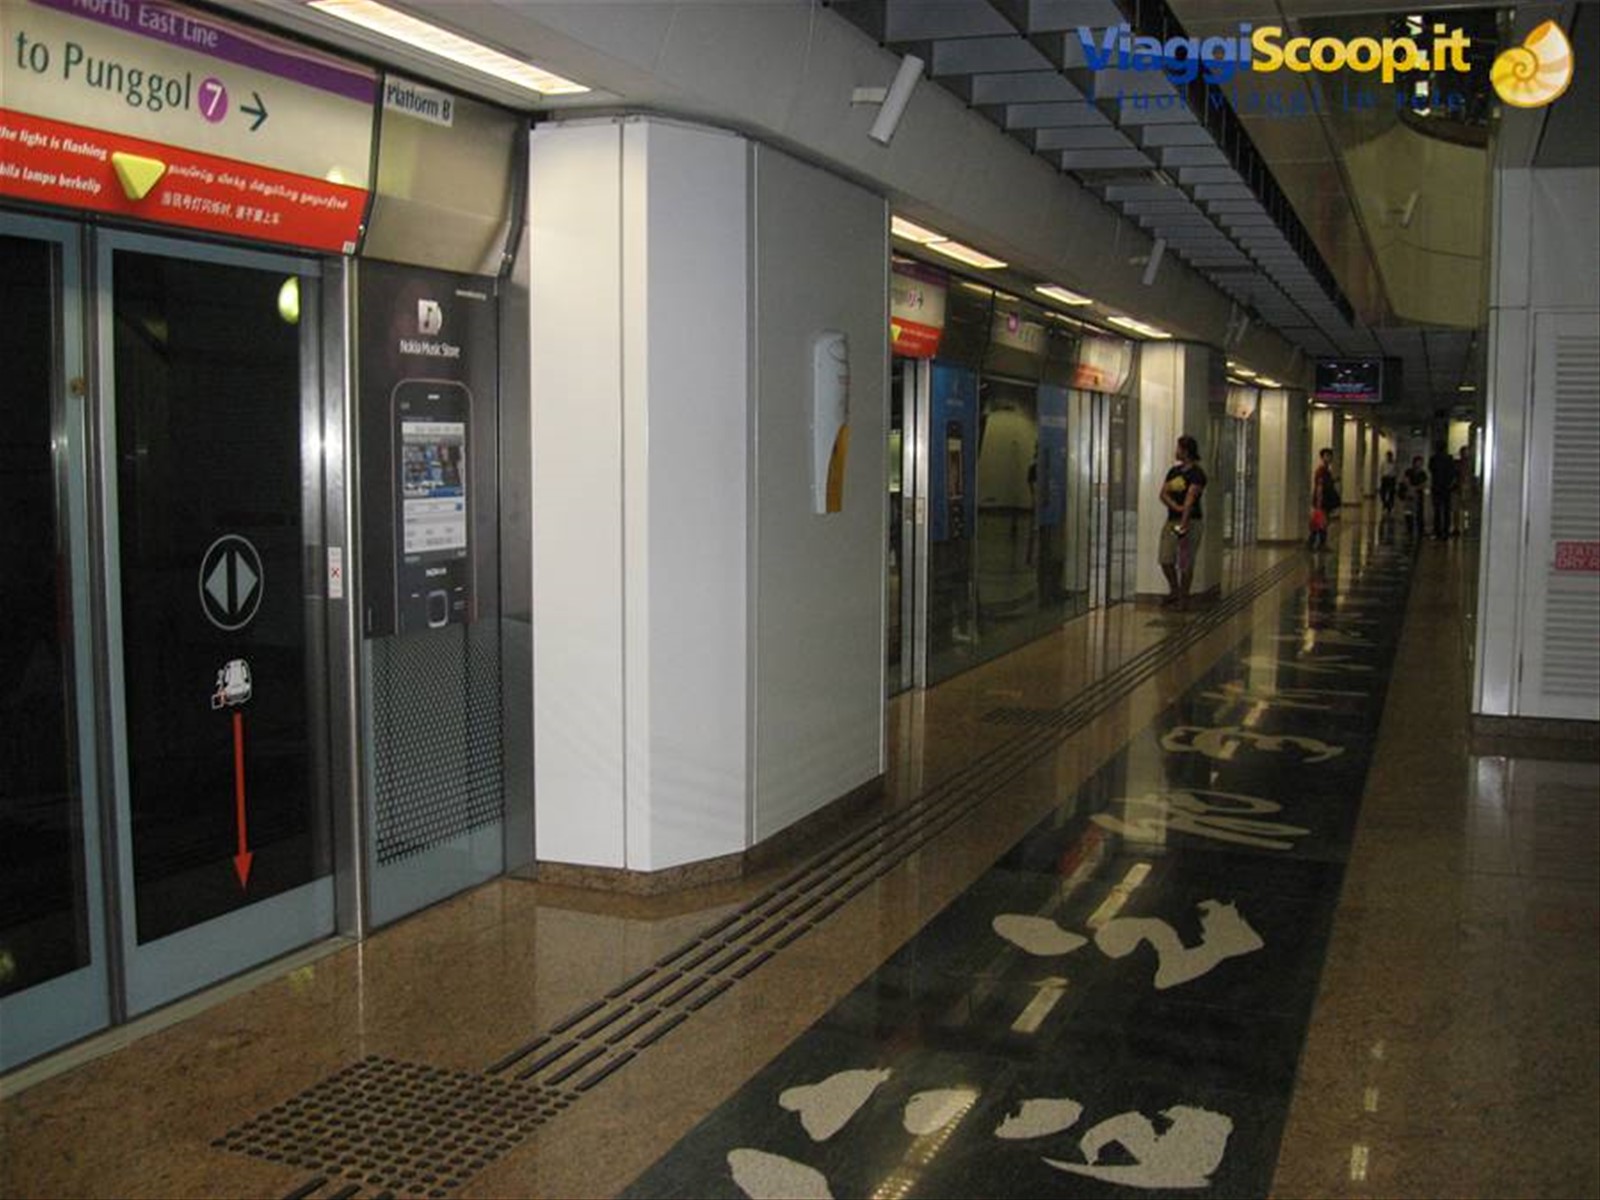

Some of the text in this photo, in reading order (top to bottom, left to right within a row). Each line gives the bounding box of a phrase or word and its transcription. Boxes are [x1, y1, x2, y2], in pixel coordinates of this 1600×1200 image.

[138, 4, 176, 36] East
[182, 19, 219, 48] Line
[17, 31, 223, 117] to Punggol 7
[386, 83, 440, 118] Platform
[19, 129, 48, 148] light
[50, 135, 60, 150] is
[62, 138, 108, 161] flashing
